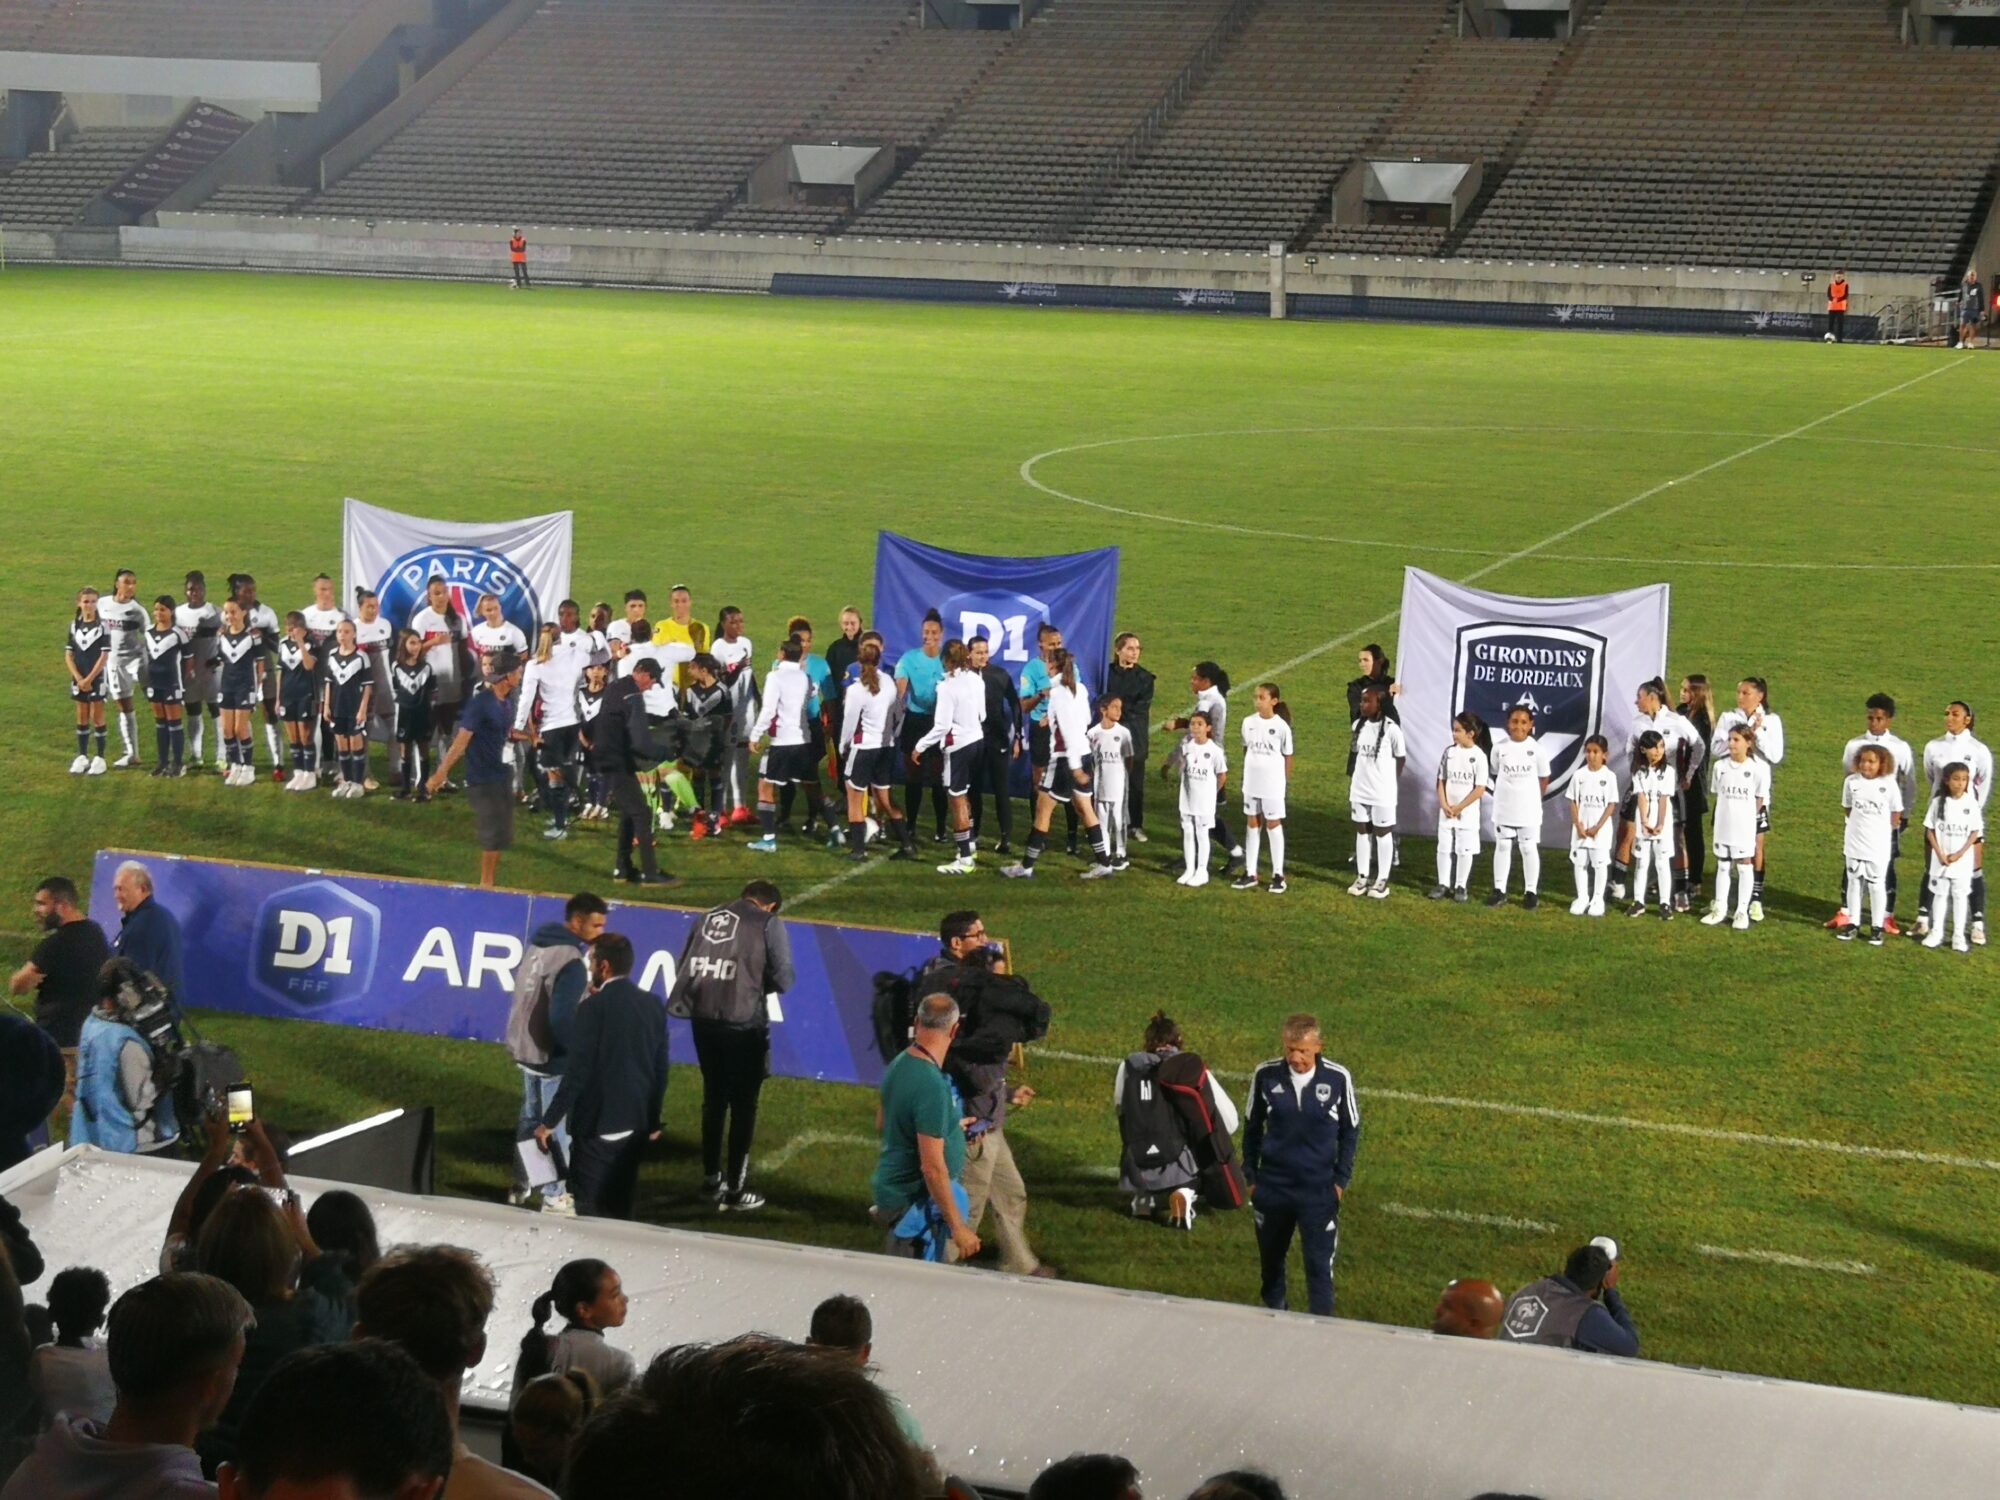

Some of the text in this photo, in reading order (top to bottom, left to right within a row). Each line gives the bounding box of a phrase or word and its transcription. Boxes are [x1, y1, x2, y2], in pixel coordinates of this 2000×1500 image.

[402, 557, 511, 596] PARIS
[959, 610, 1029, 662] D1
[1474, 643, 1587, 667] GIRONDINS
[1473, 664, 1584, 688] DE BORDEAUX
[273, 909, 353, 974] D1
[287, 977, 329, 993] FFF
